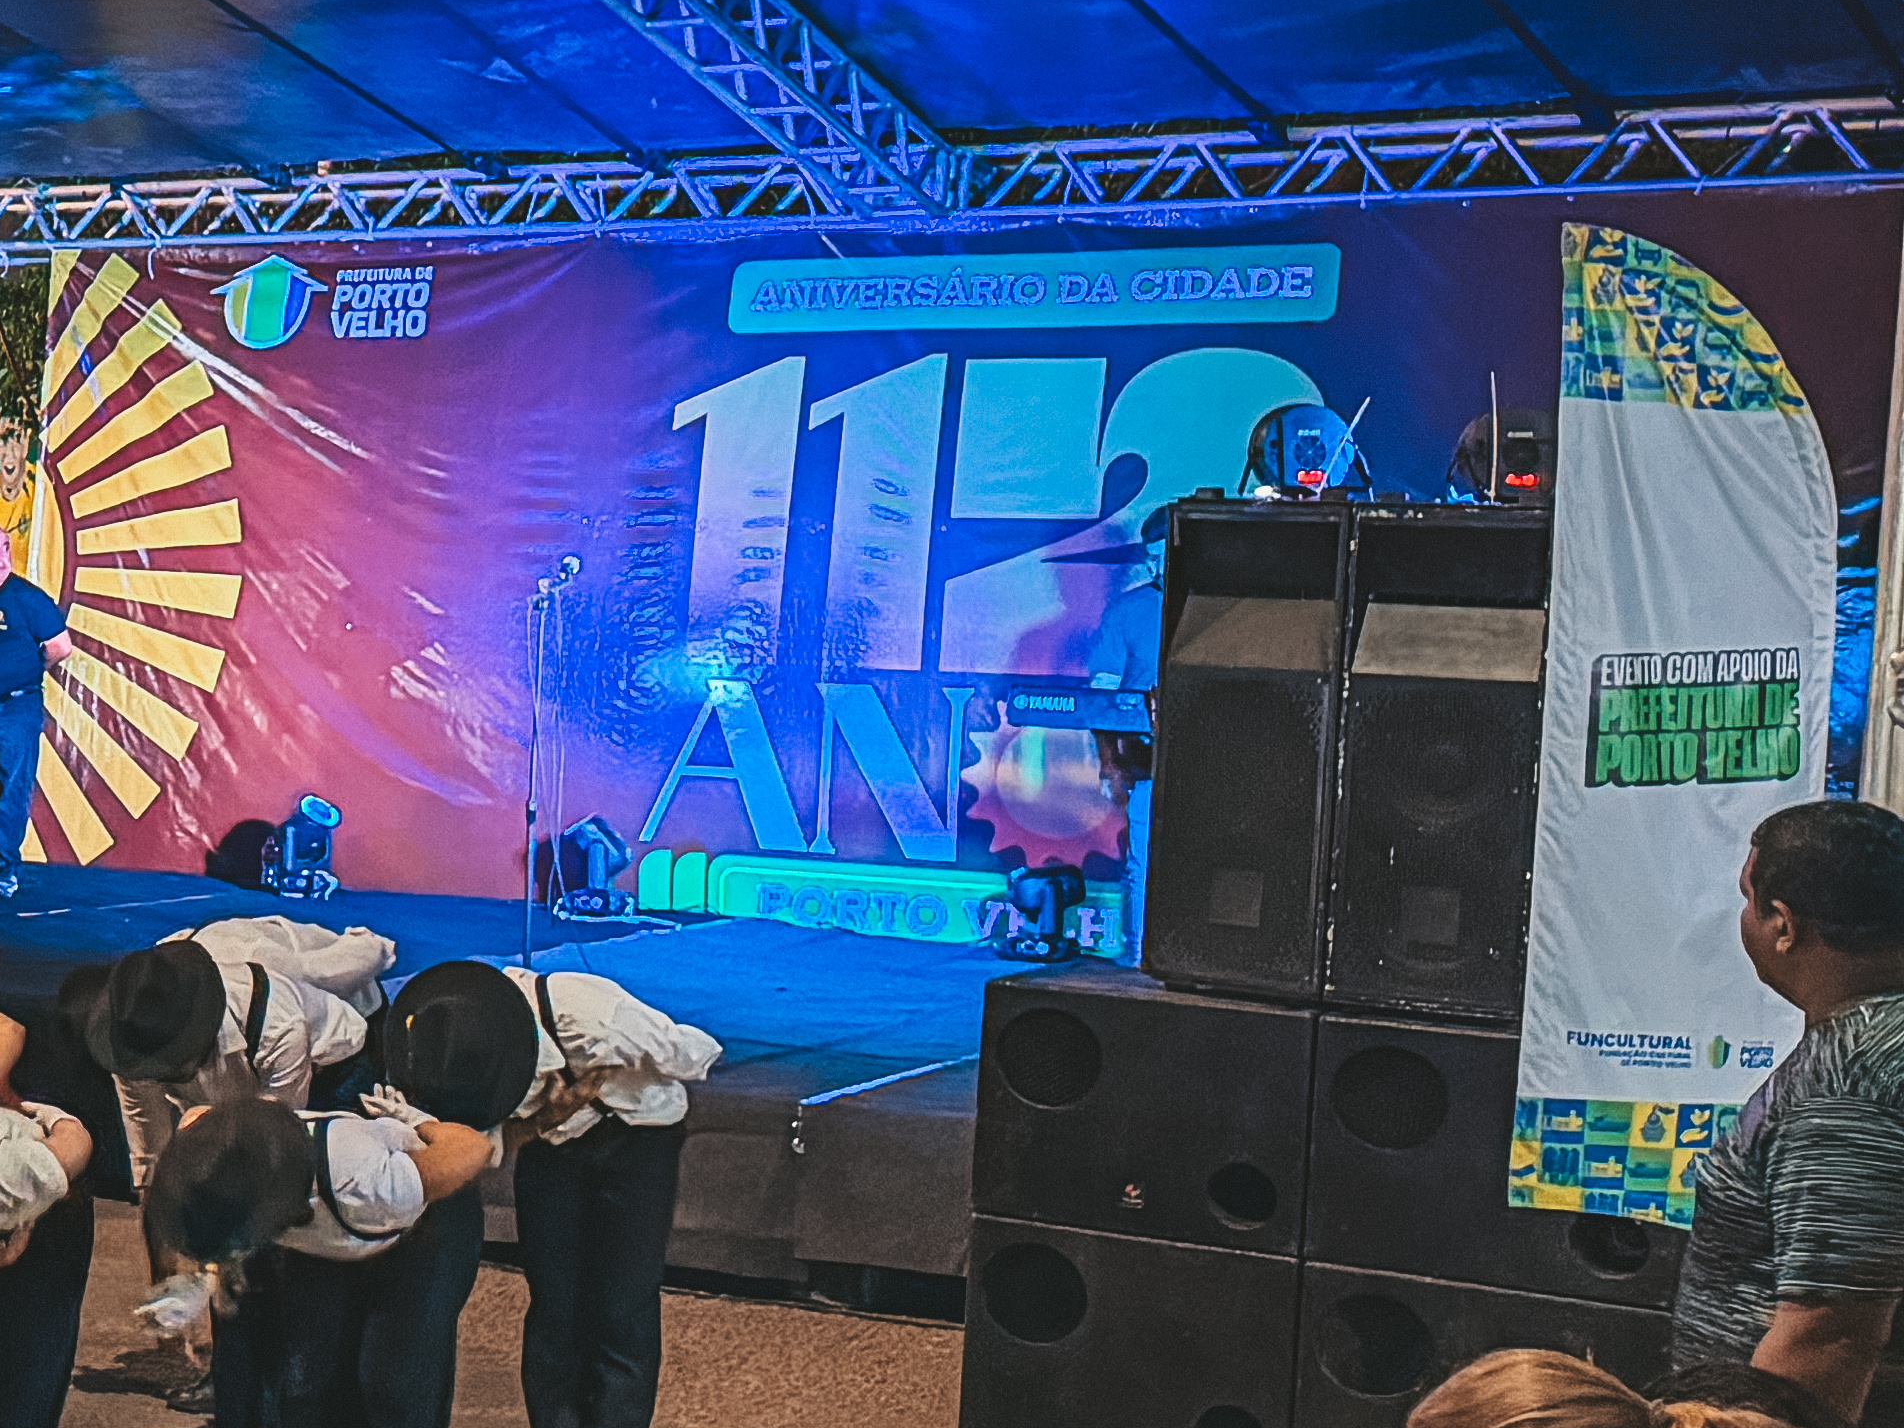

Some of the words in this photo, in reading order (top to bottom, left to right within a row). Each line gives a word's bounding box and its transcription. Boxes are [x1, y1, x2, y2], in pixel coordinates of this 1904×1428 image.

[336, 268, 412, 283] PREFEITURA
[415, 265, 433, 281] DE
[750, 266, 1047, 312] ANIVERSÁRIO
[1056, 273, 1120, 304] DA
[1131, 266, 1314, 301] CIDADE
[332, 282, 430, 310] PORTO
[330, 309, 428, 339] VELHO
[1600, 655, 1662, 686] EVENTO
[1666, 651, 1714, 684] COM
[1716, 649, 1772, 682] APOIO
[1775, 647, 1798, 680] DA
[1598, 684, 1760, 732] PREFEITURA
[1764, 682, 1798, 726] DE
[1595, 731, 1699, 783] PORTO
[1705, 726, 1800, 779] VELHO
[756, 882, 948, 936] PORTO
[1566, 1030, 1692, 1051] FUNCULTURAL
